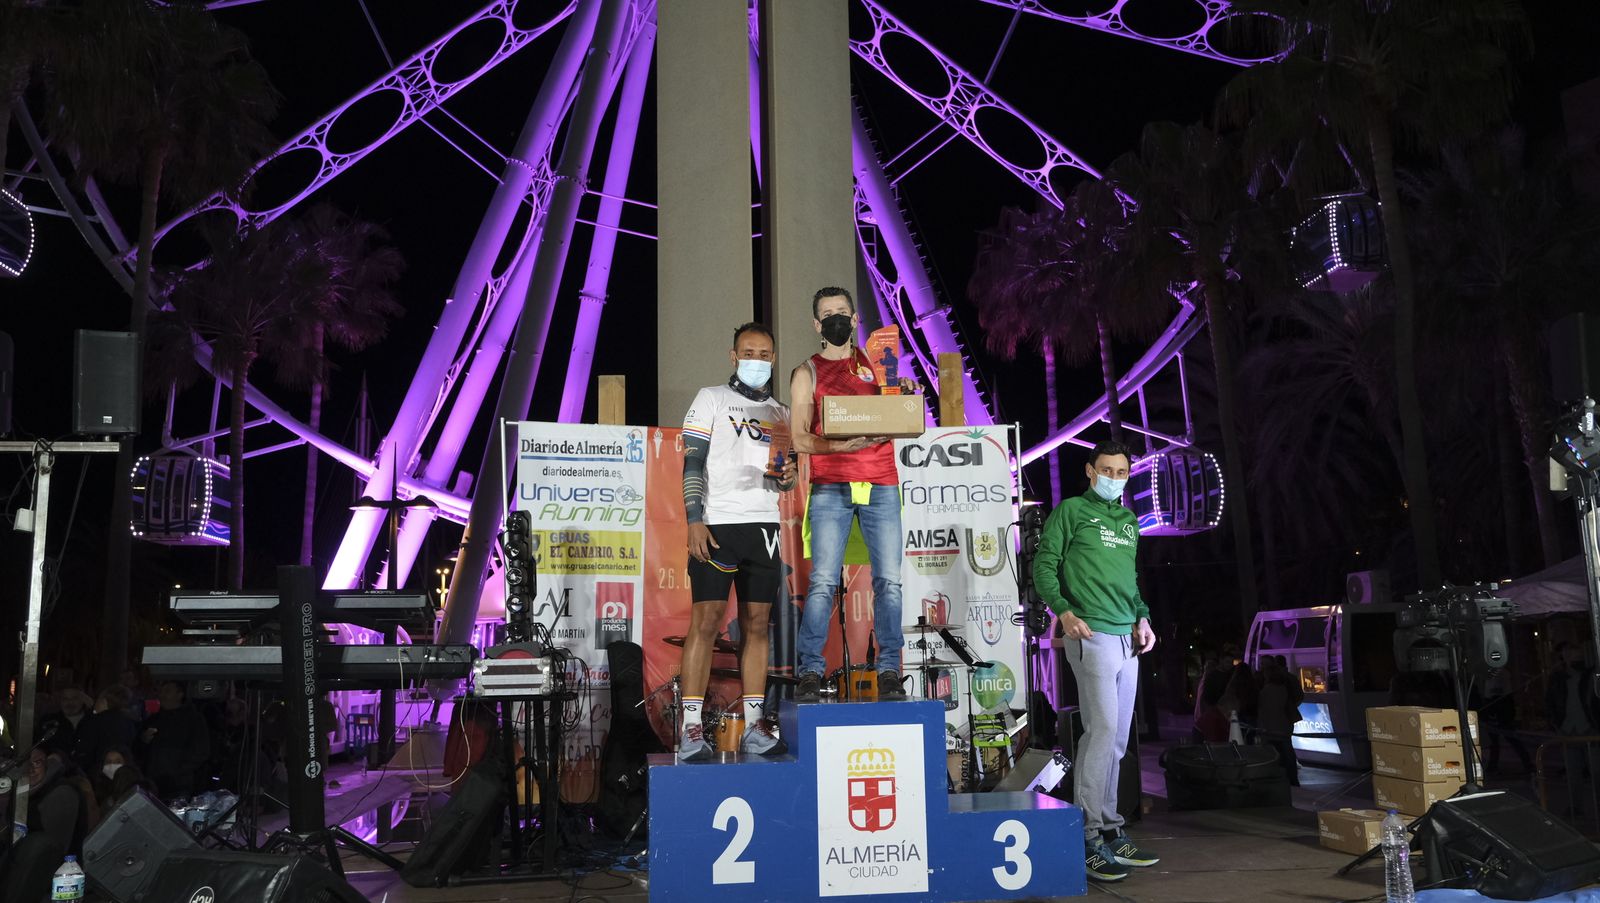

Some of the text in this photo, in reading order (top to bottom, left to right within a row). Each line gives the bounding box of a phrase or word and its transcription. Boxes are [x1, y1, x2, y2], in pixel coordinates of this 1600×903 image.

[521, 439, 623, 456] Diario de Almería
[900, 442, 984, 468] CASI
[542, 466, 624, 479] diariodealmeria.es
[902, 480, 1007, 506] formas
[539, 503, 643, 526] Running
[550, 532, 590, 543] GRUAS
[905, 528, 960, 549] AMSA
[550, 546, 563, 558] EL
[619, 547, 638, 559] S.A.
[551, 563, 636, 571] www.gruaselcanario.net
[302, 602, 313, 637] PRO
[968, 605, 1013, 622] ARTURO
[304, 639, 316, 696] SPIDER
[712, 796, 755, 884] 2
[826, 840, 921, 865] ALMERÍA
[992, 819, 1032, 890] 3
[849, 865, 898, 879] CIUDAD
